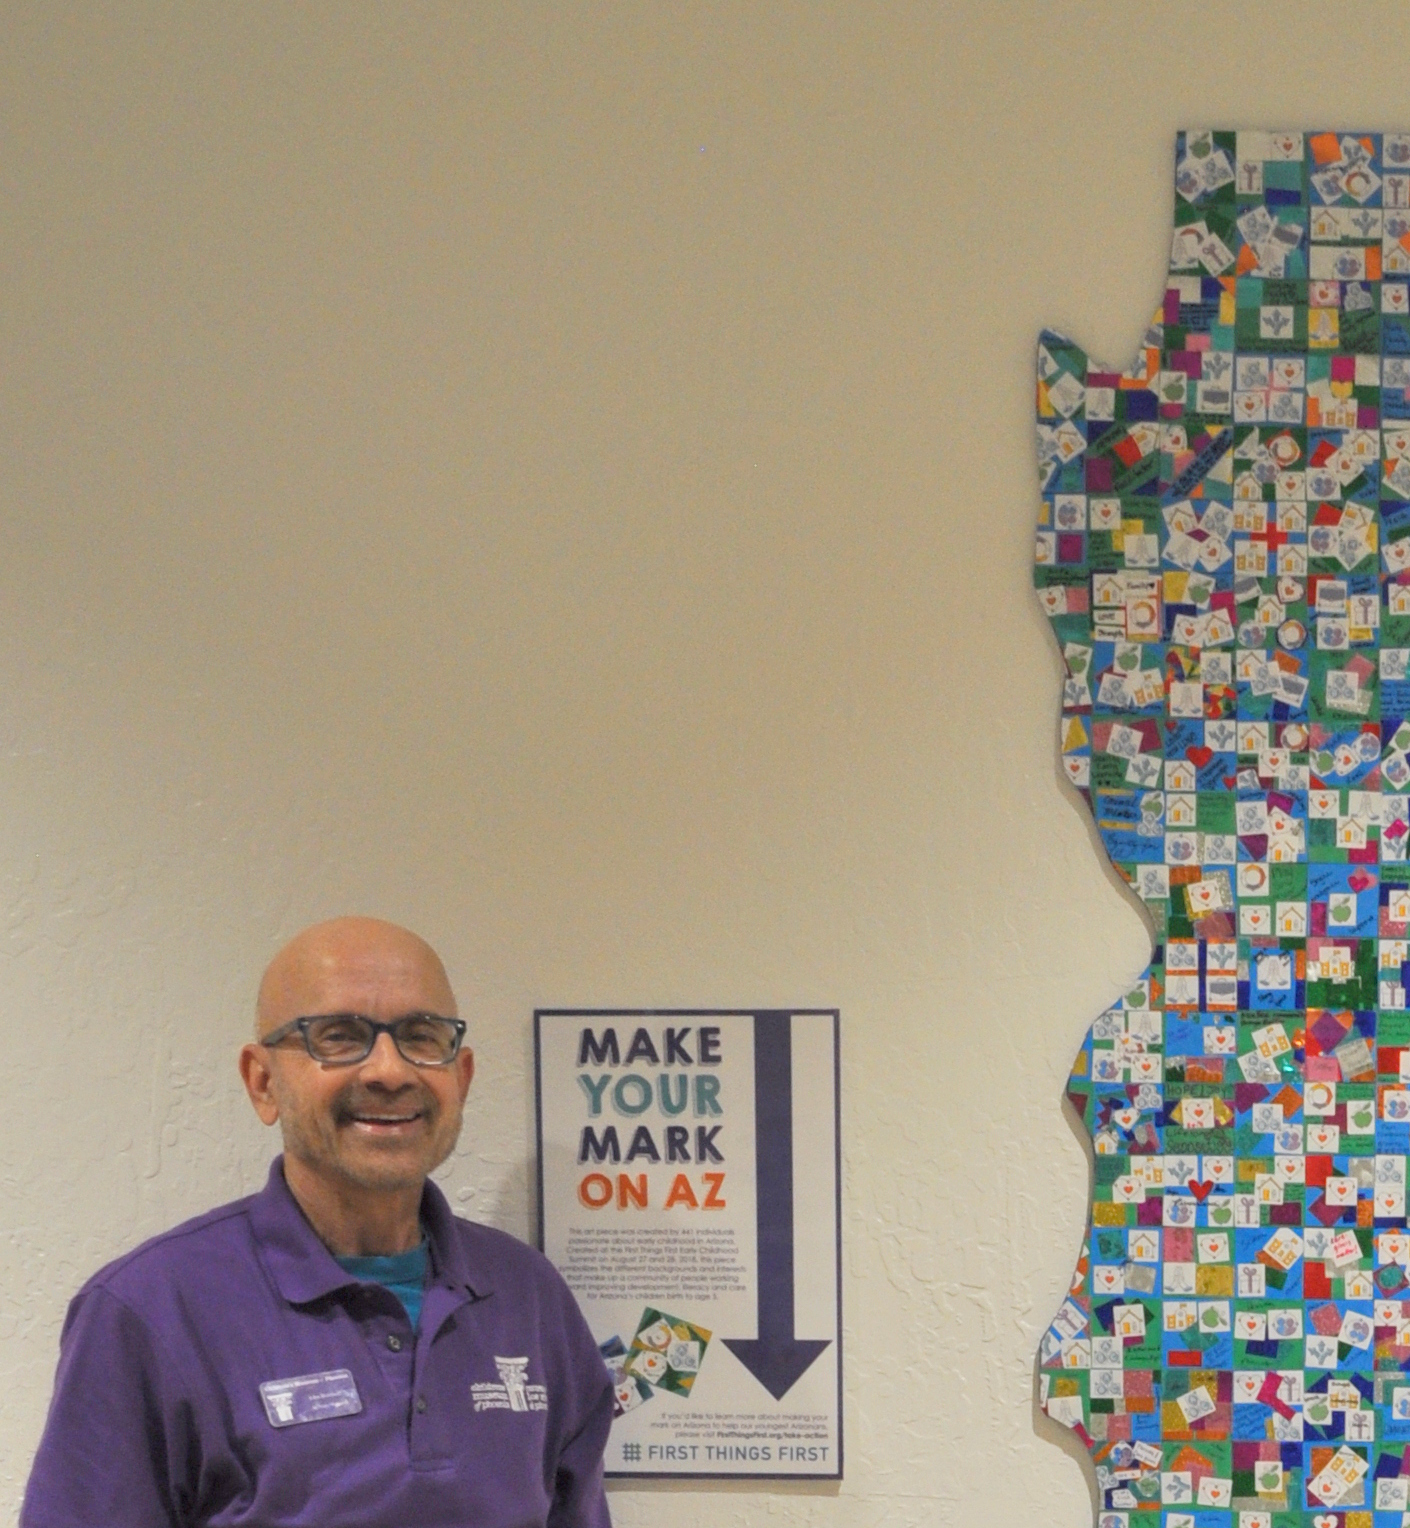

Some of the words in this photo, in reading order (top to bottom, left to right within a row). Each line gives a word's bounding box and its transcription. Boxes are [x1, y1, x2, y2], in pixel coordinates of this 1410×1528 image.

[577, 1027, 722, 1067] MAKE
[578, 1074, 723, 1118] YOUR
[577, 1125, 726, 1164] MARK
[577, 1172, 649, 1211] ON
[663, 1172, 727, 1210] AZ
[648, 1445, 699, 1460] FIRST
[705, 1446, 771, 1461] THINGS
[778, 1447, 830, 1462] FIRST
